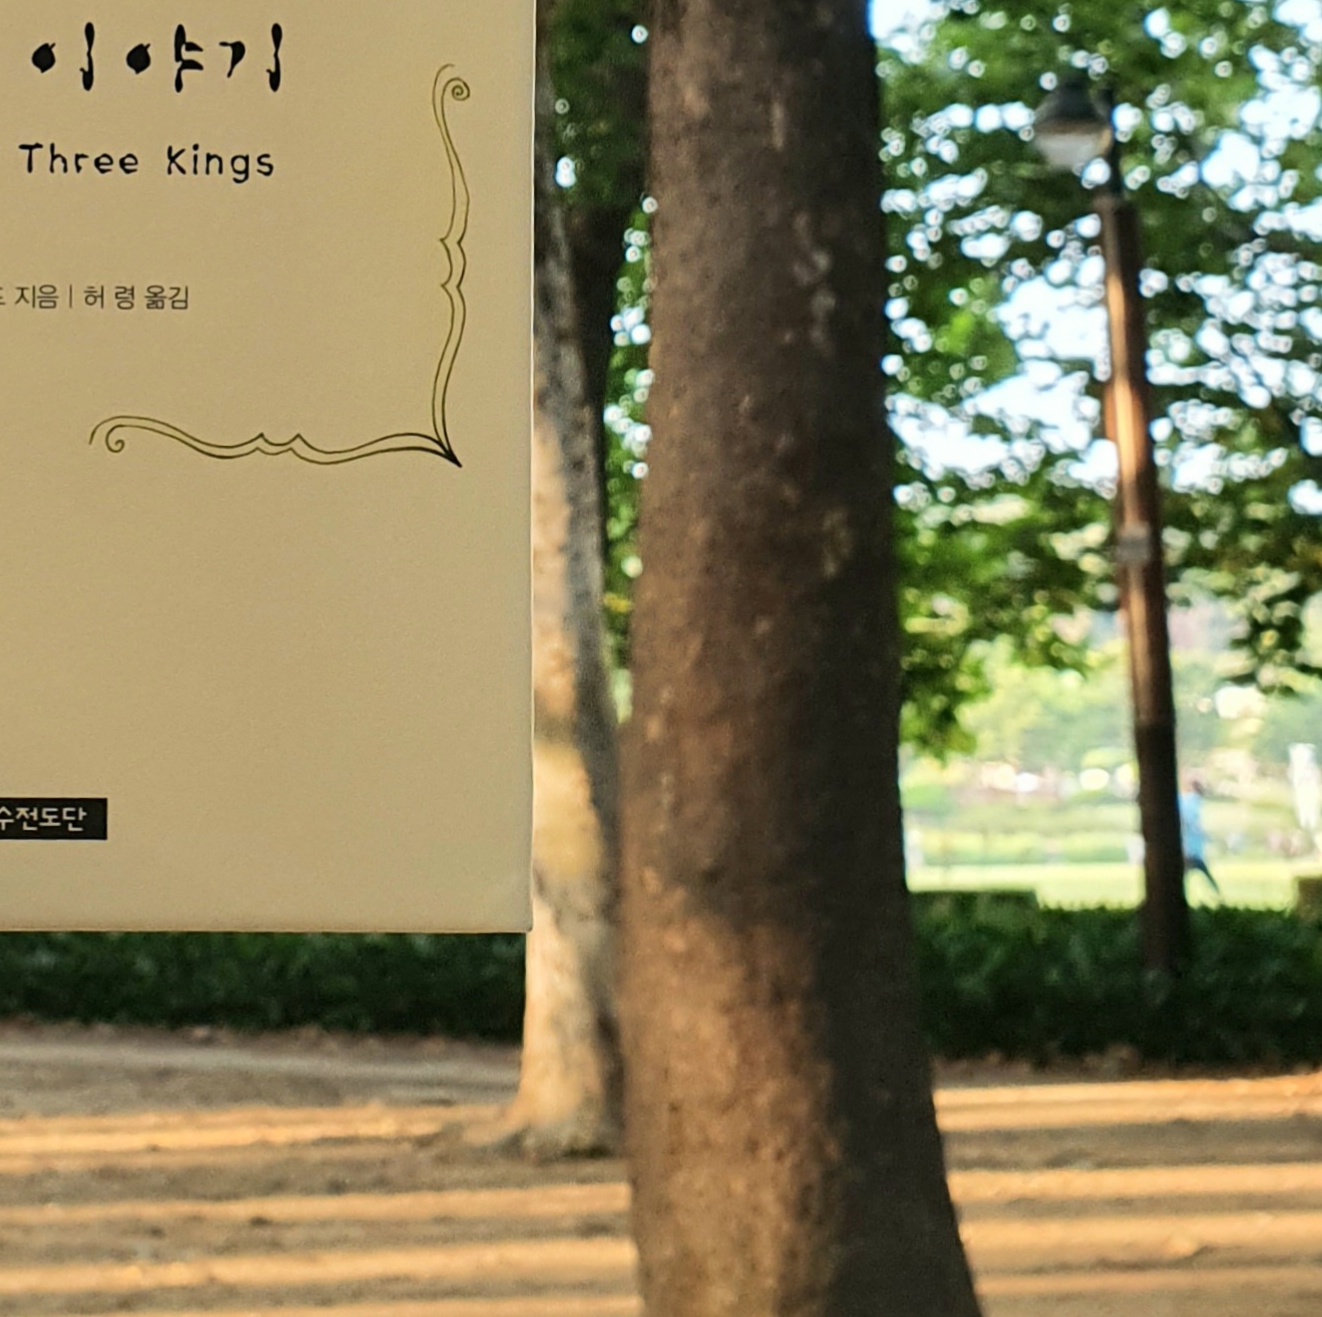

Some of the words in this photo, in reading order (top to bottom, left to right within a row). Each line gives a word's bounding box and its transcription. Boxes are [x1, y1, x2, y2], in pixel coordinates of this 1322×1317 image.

[30, 21, 284, 94] 이야기
[17, 141, 139, 175] Three
[166, 142, 275, 185] Kings
[14, 284, 59, 310] 지음
[83, 284, 105, 309] 허
[114, 285, 135, 311] 령
[144, 284, 189, 311] 옮김
